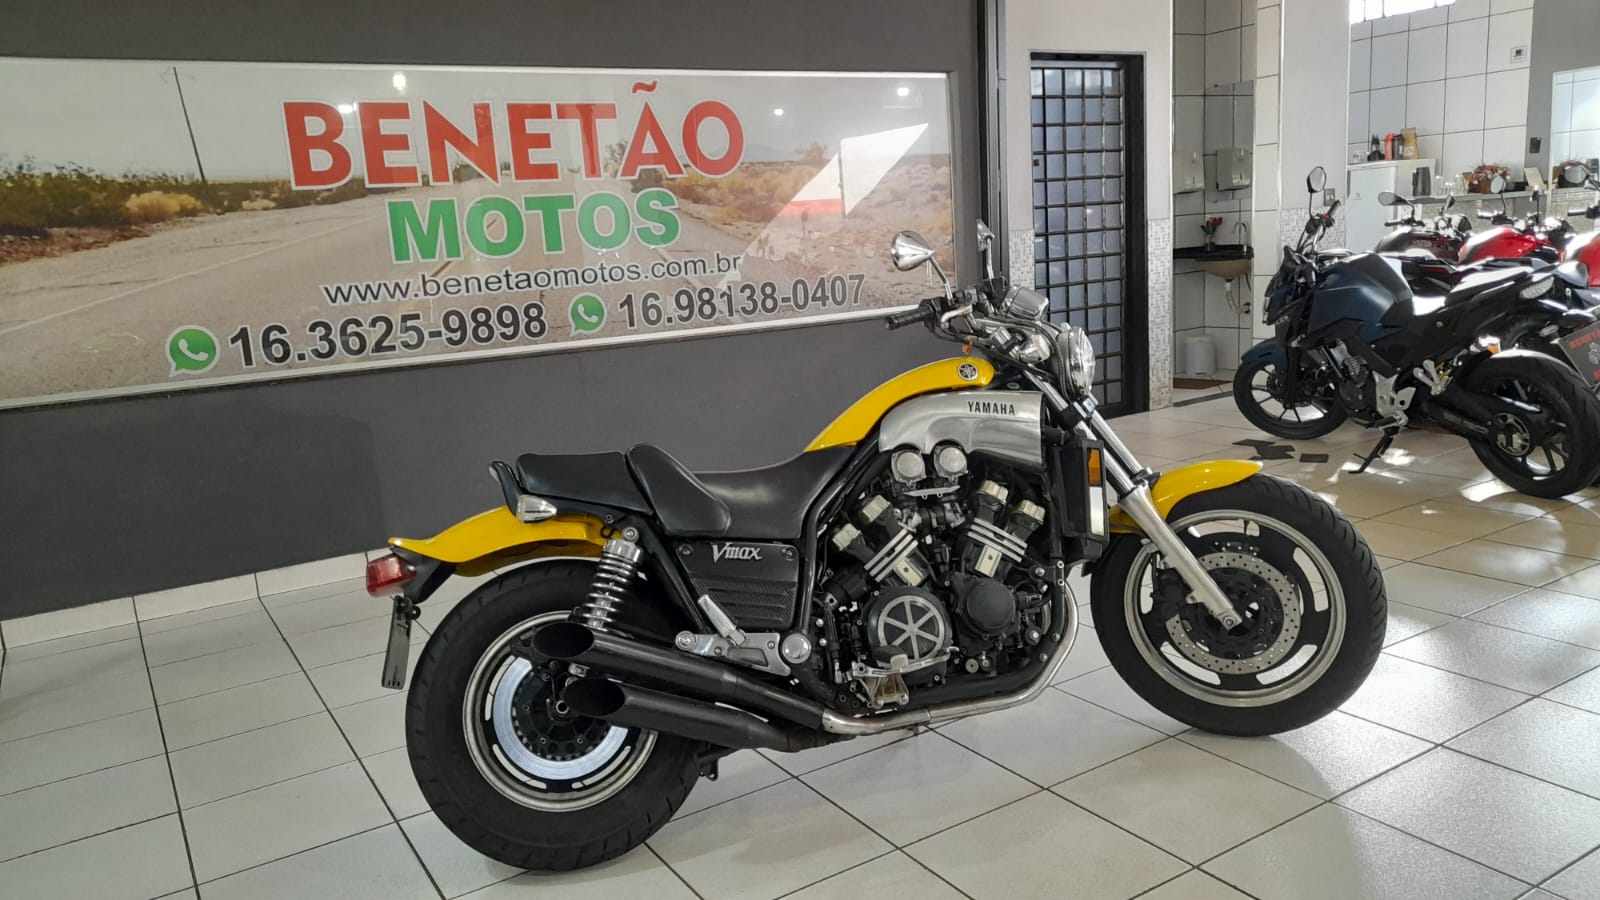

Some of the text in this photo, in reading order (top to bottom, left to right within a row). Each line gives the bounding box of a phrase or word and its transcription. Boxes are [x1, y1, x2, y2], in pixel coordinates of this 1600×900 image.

[283, 80, 745, 189] BENETÃO
[387, 189, 681, 263] MOTOS
[322, 251, 742, 305] www.benetaomotos.com.br
[619, 273, 865, 328] 16.98138-0407
[229, 301, 547, 367] 16.3625-9898
[967, 400, 1016, 416] YAMAHA
[710, 542, 763, 563] Vmax
